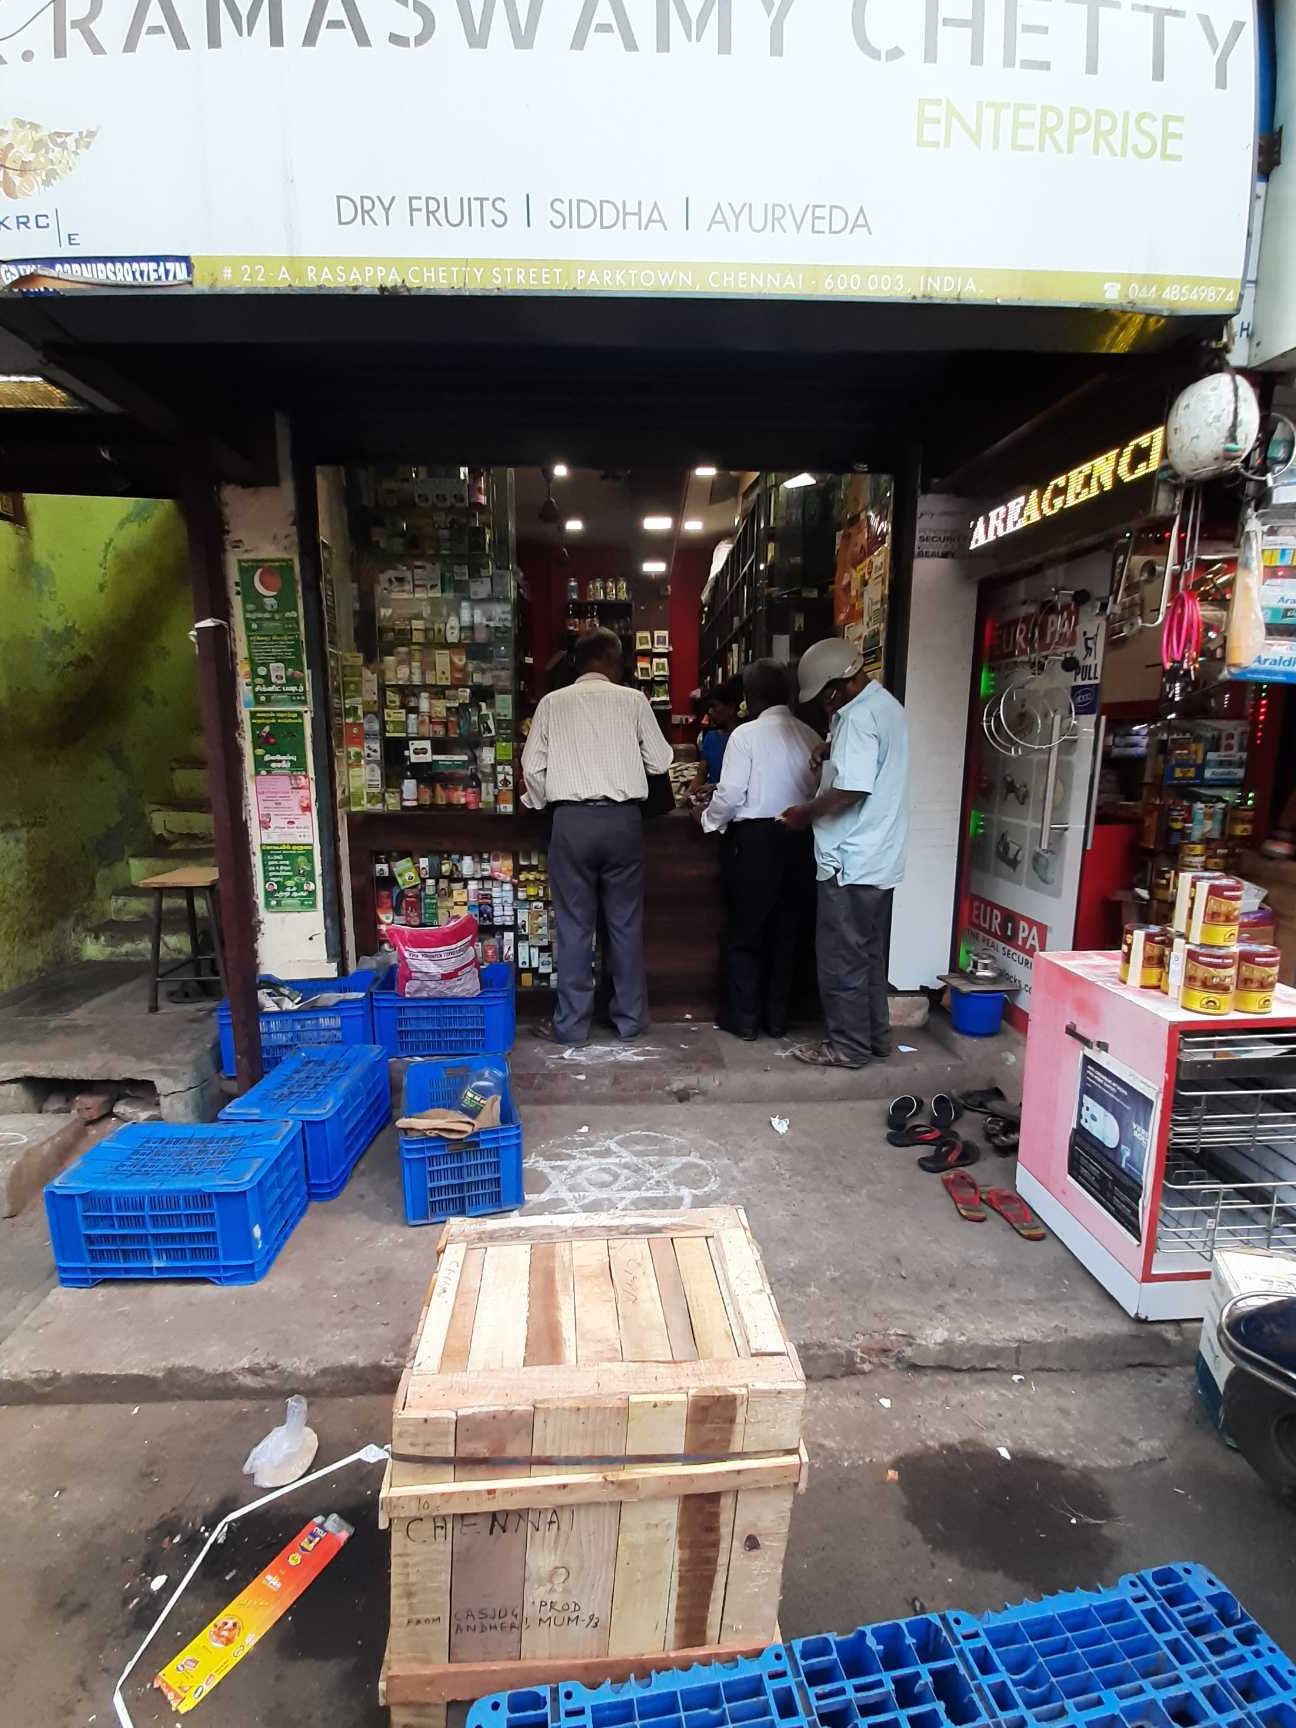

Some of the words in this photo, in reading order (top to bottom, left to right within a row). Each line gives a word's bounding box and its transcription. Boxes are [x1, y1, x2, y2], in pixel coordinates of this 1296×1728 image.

[851, 0, 1247, 90] CHETTY
[915, 97, 1185, 162] ENTERPRISE
[335, 194, 396, 227] DRY
[408, 196, 508, 228] FRUITS
[549, 197, 668, 232] SIDDHA
[706, 200, 873, 236] AYURVEDA
[67, 233, 81, 246] E
[221, 266, 232, 280] #
[307, 266, 400, 283] RASAPPA
[408, 265, 485, 284] CHETTY
[707, 270, 803, 289] CHENNAI
[823, 273, 860, 290] 600
[1128, 283, 1157, 299] 044
[1161, 284, 1234, 303] 48549874
[1072, 663, 1098, 682] PULL
[405, 1508, 576, 1544] CHENNAI
